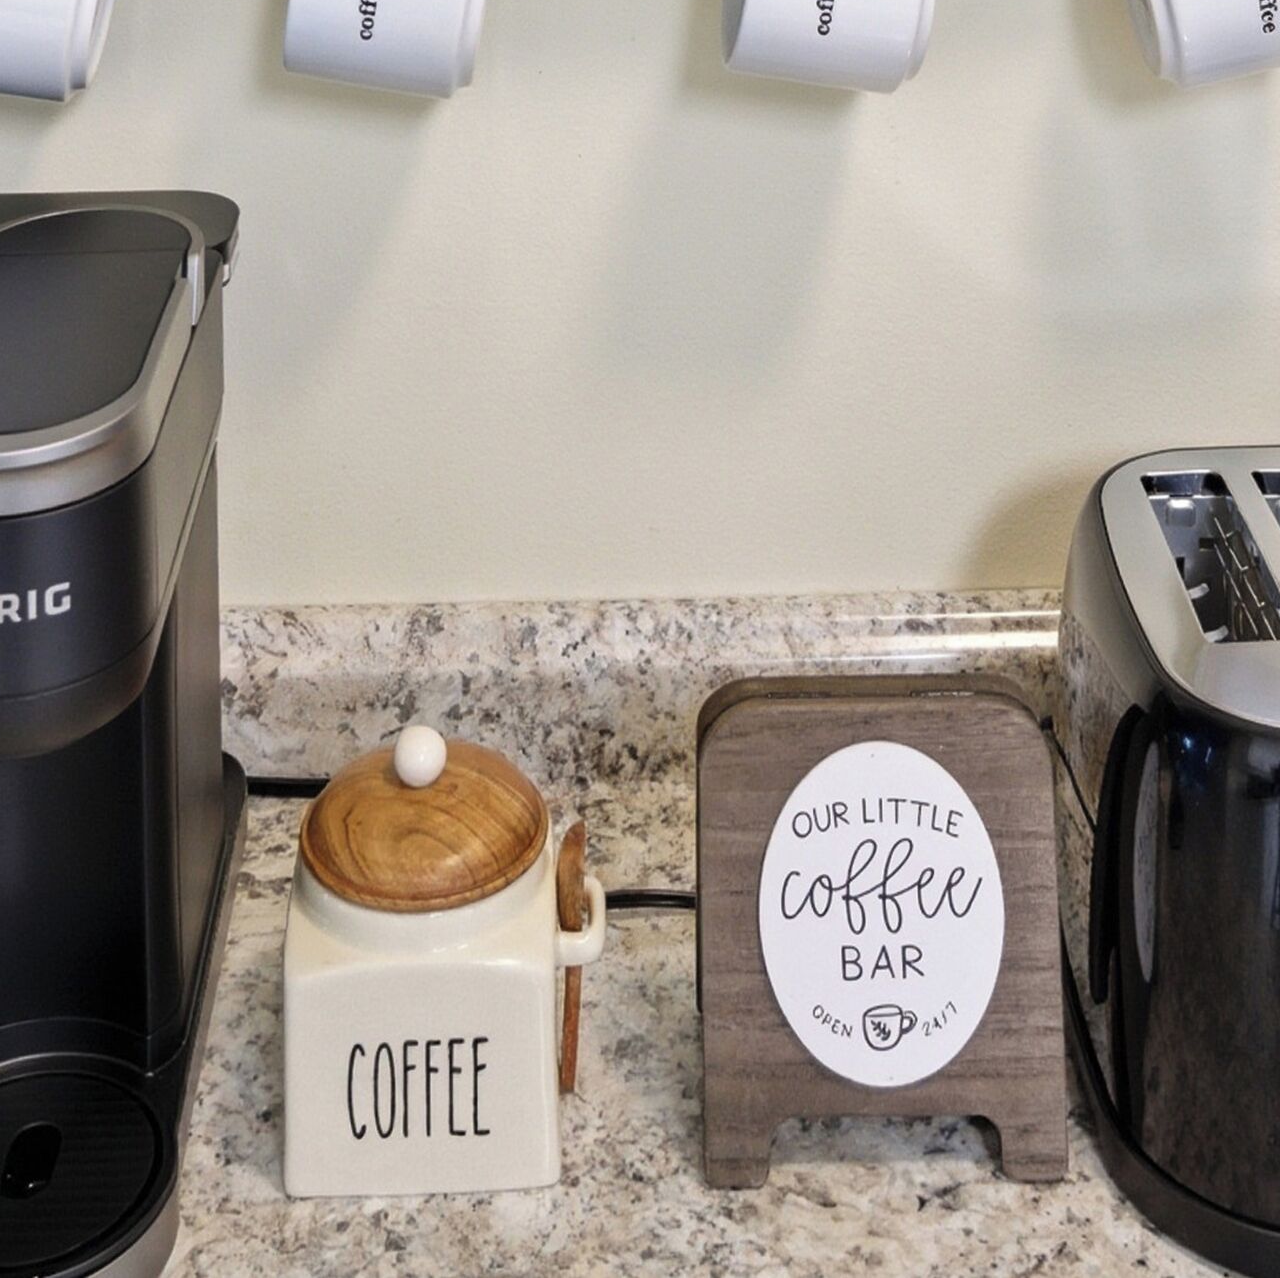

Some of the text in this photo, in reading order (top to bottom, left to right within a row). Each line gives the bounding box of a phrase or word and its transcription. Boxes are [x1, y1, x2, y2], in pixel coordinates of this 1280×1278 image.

[792, 798, 964, 838] OUR LITTLE
[781, 838, 983, 935] coffee
[841, 944, 925, 981] BAR
[812, 1001, 958, 1038] OPEN 24/7
[348, 1037, 490, 1140] COFFEE
